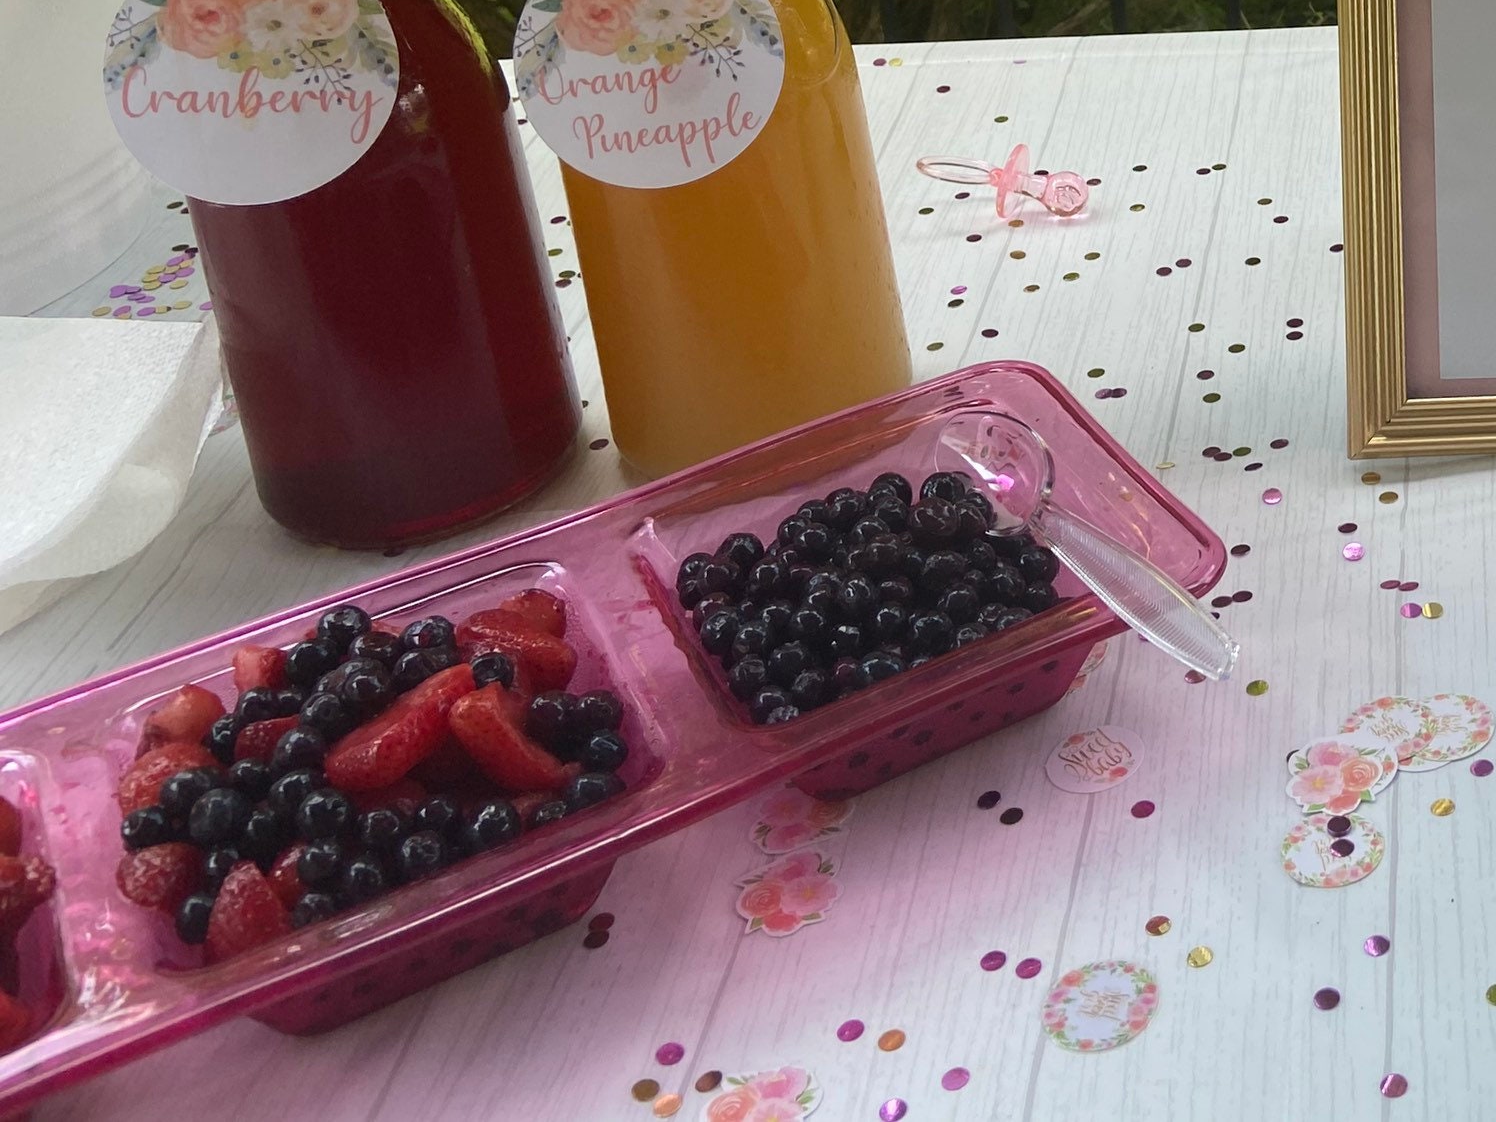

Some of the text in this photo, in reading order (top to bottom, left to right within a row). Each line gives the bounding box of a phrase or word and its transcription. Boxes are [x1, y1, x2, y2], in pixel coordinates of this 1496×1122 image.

[122, 64, 383, 144] Cranberry
[536, 63, 682, 114] Orange
[572, 92, 762, 168] Pineapple
